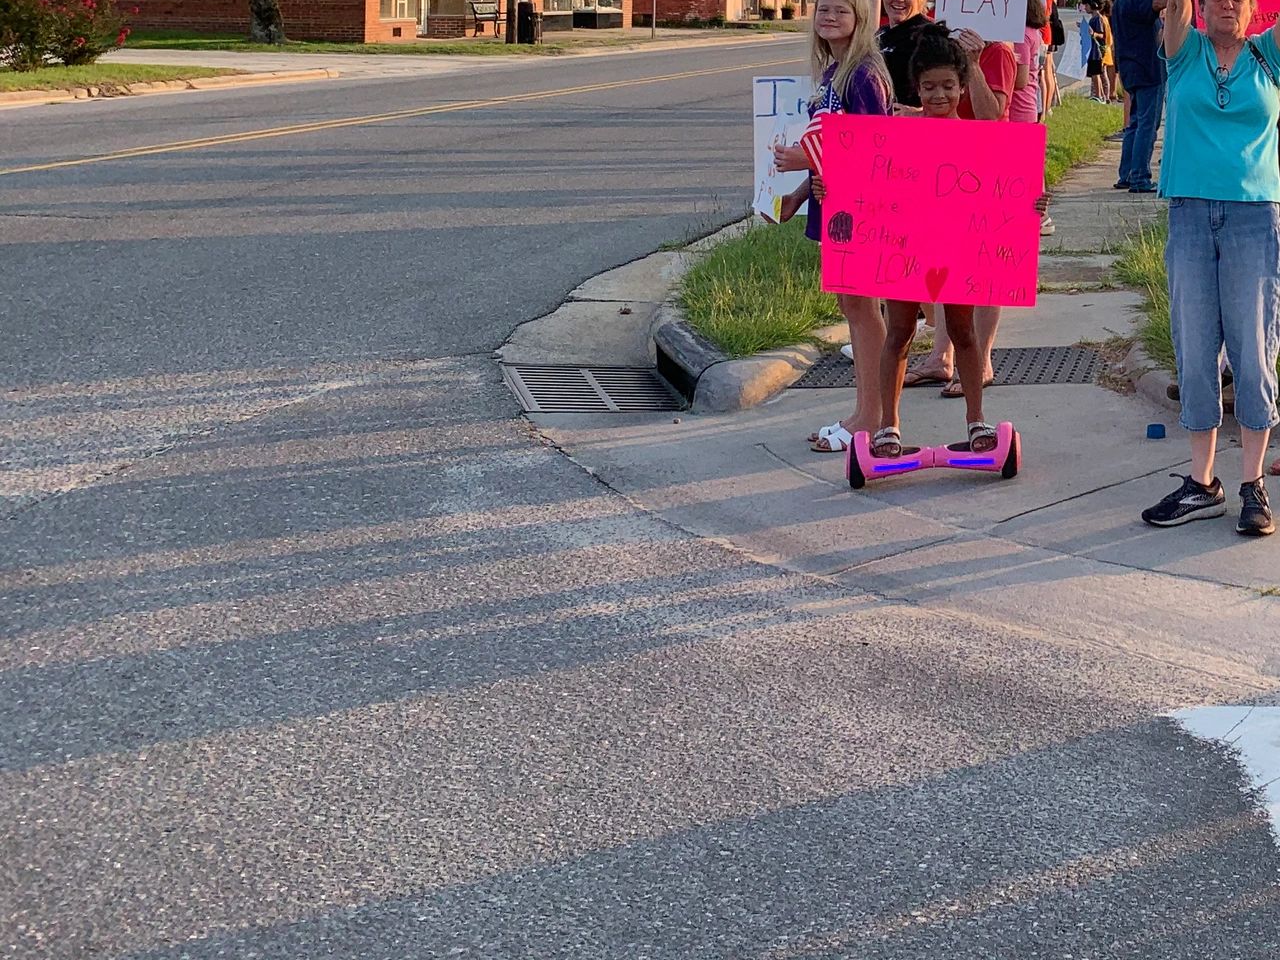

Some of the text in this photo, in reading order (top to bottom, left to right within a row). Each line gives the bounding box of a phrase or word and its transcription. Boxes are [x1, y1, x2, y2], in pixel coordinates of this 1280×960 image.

[935, 163, 982, 197] DO
[992, 175, 1031, 200] NO
[825, 248, 857, 290] I
